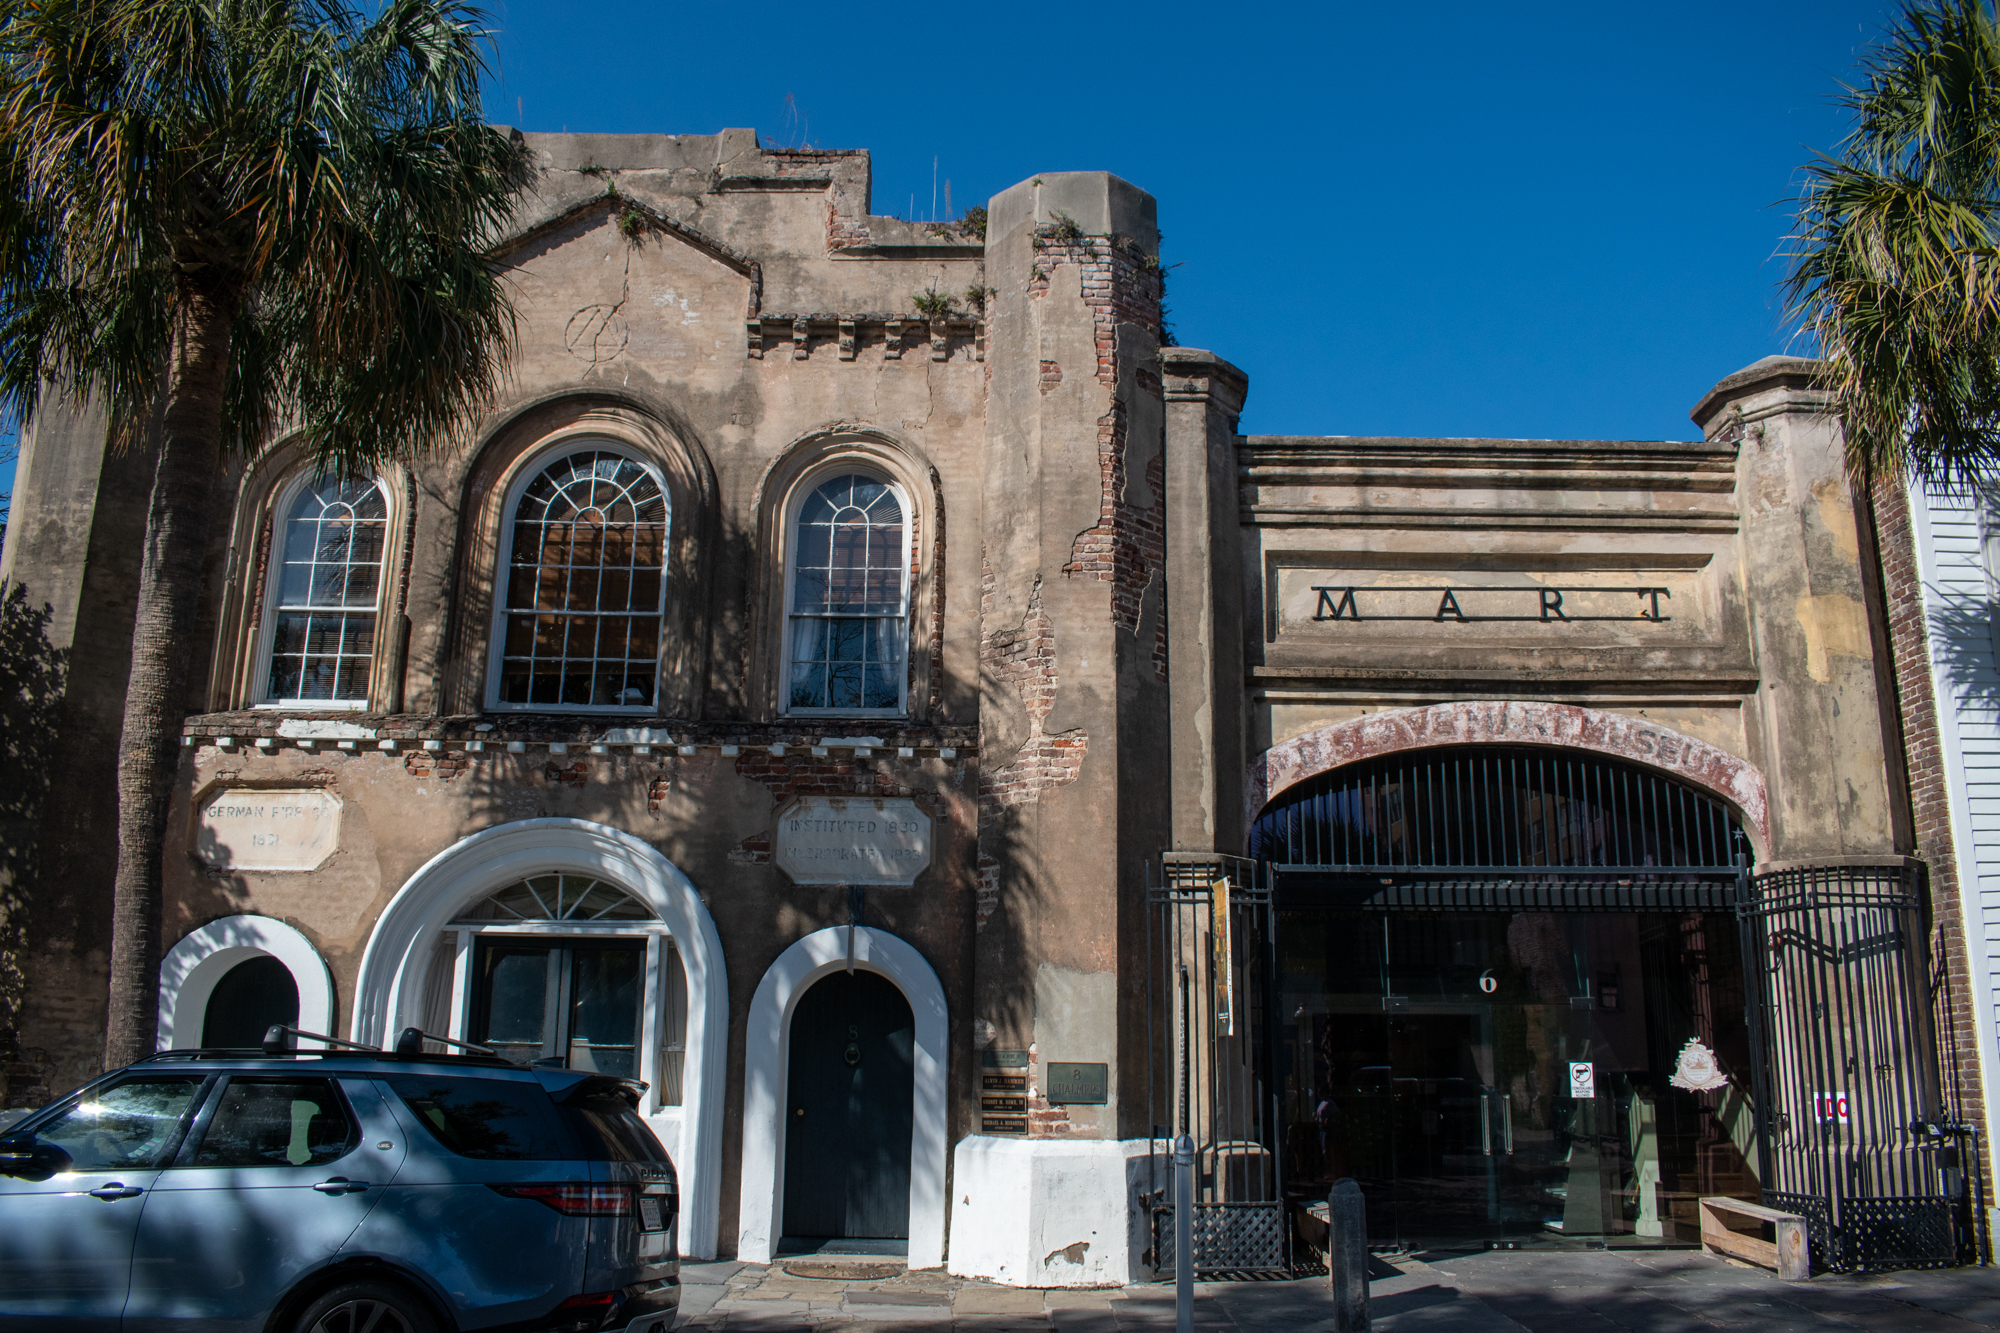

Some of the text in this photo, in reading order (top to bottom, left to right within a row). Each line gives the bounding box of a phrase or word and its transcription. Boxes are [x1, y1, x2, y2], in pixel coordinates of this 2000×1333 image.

[1311, 586, 1671, 622] MART
[208, 806, 264, 818] GERMAN
[271, 806, 303, 819] FIRE
[790, 820, 919, 834] INSTITUTED 1830
[784, 847, 884, 860] INCORPORATED
[1479, 968, 1498, 994] 6
[848, 1024, 859, 1040] 8
[1073, 1069, 1082, 1081] 8
[1052, 1082, 1102, 1096] CHALMERS
